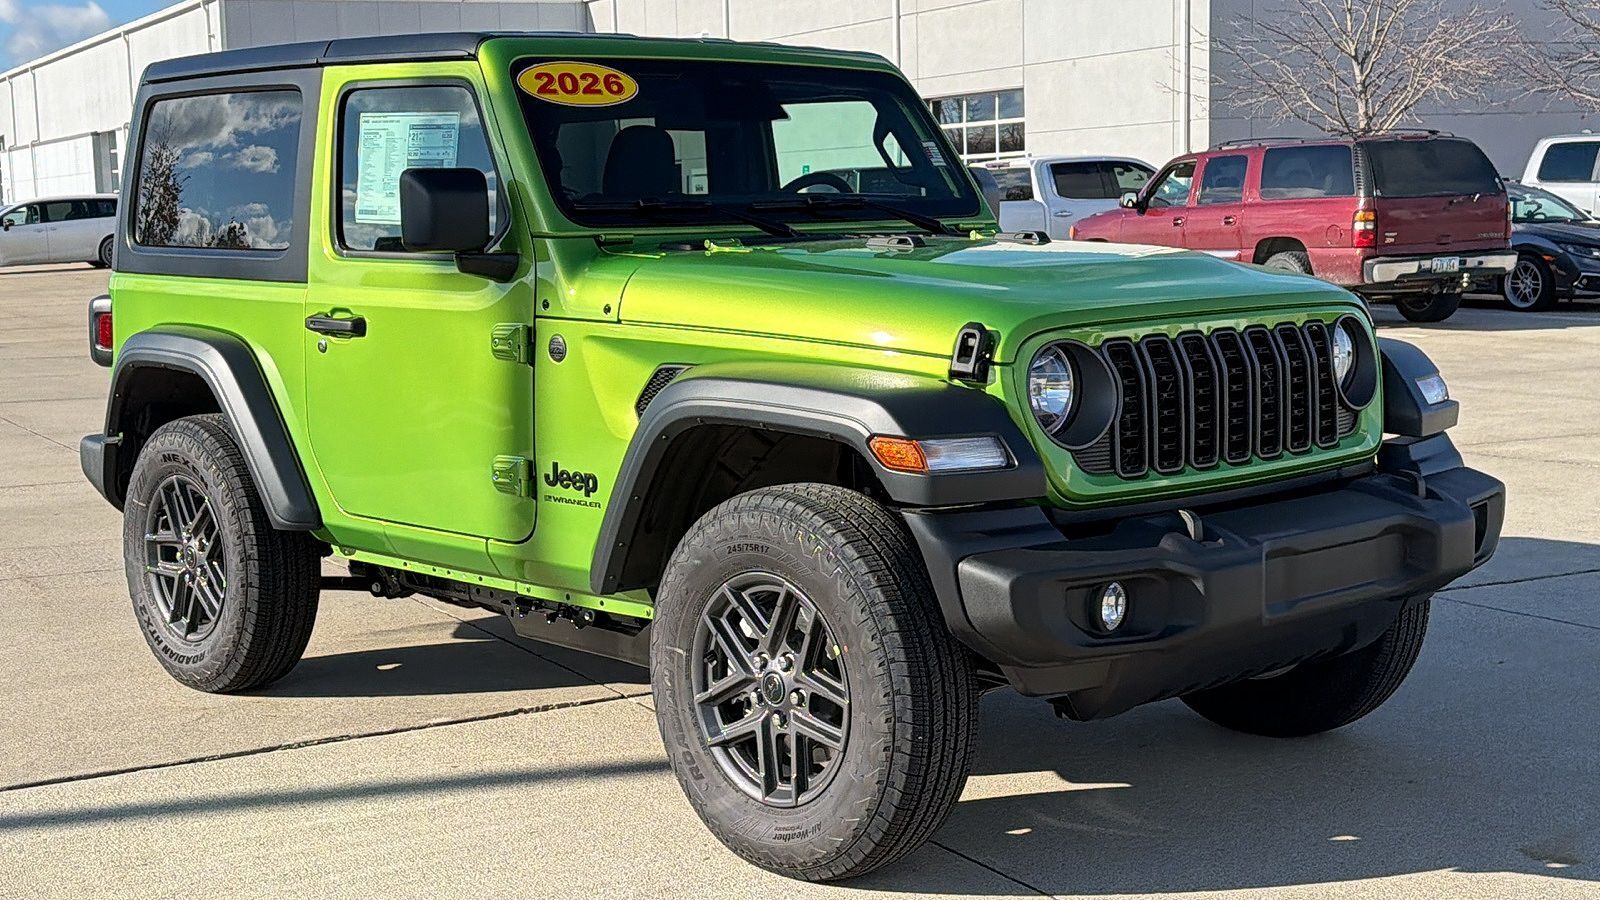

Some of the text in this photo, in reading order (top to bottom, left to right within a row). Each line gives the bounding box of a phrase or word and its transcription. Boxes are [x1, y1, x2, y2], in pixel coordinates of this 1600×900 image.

[533, 71, 626, 96] 2026
[543, 461, 599, 498] Jeep
[552, 495, 602, 509] WRANGLER
[726, 542, 770, 555] 245/75R17
[772, 821, 822, 843] All-Weather
